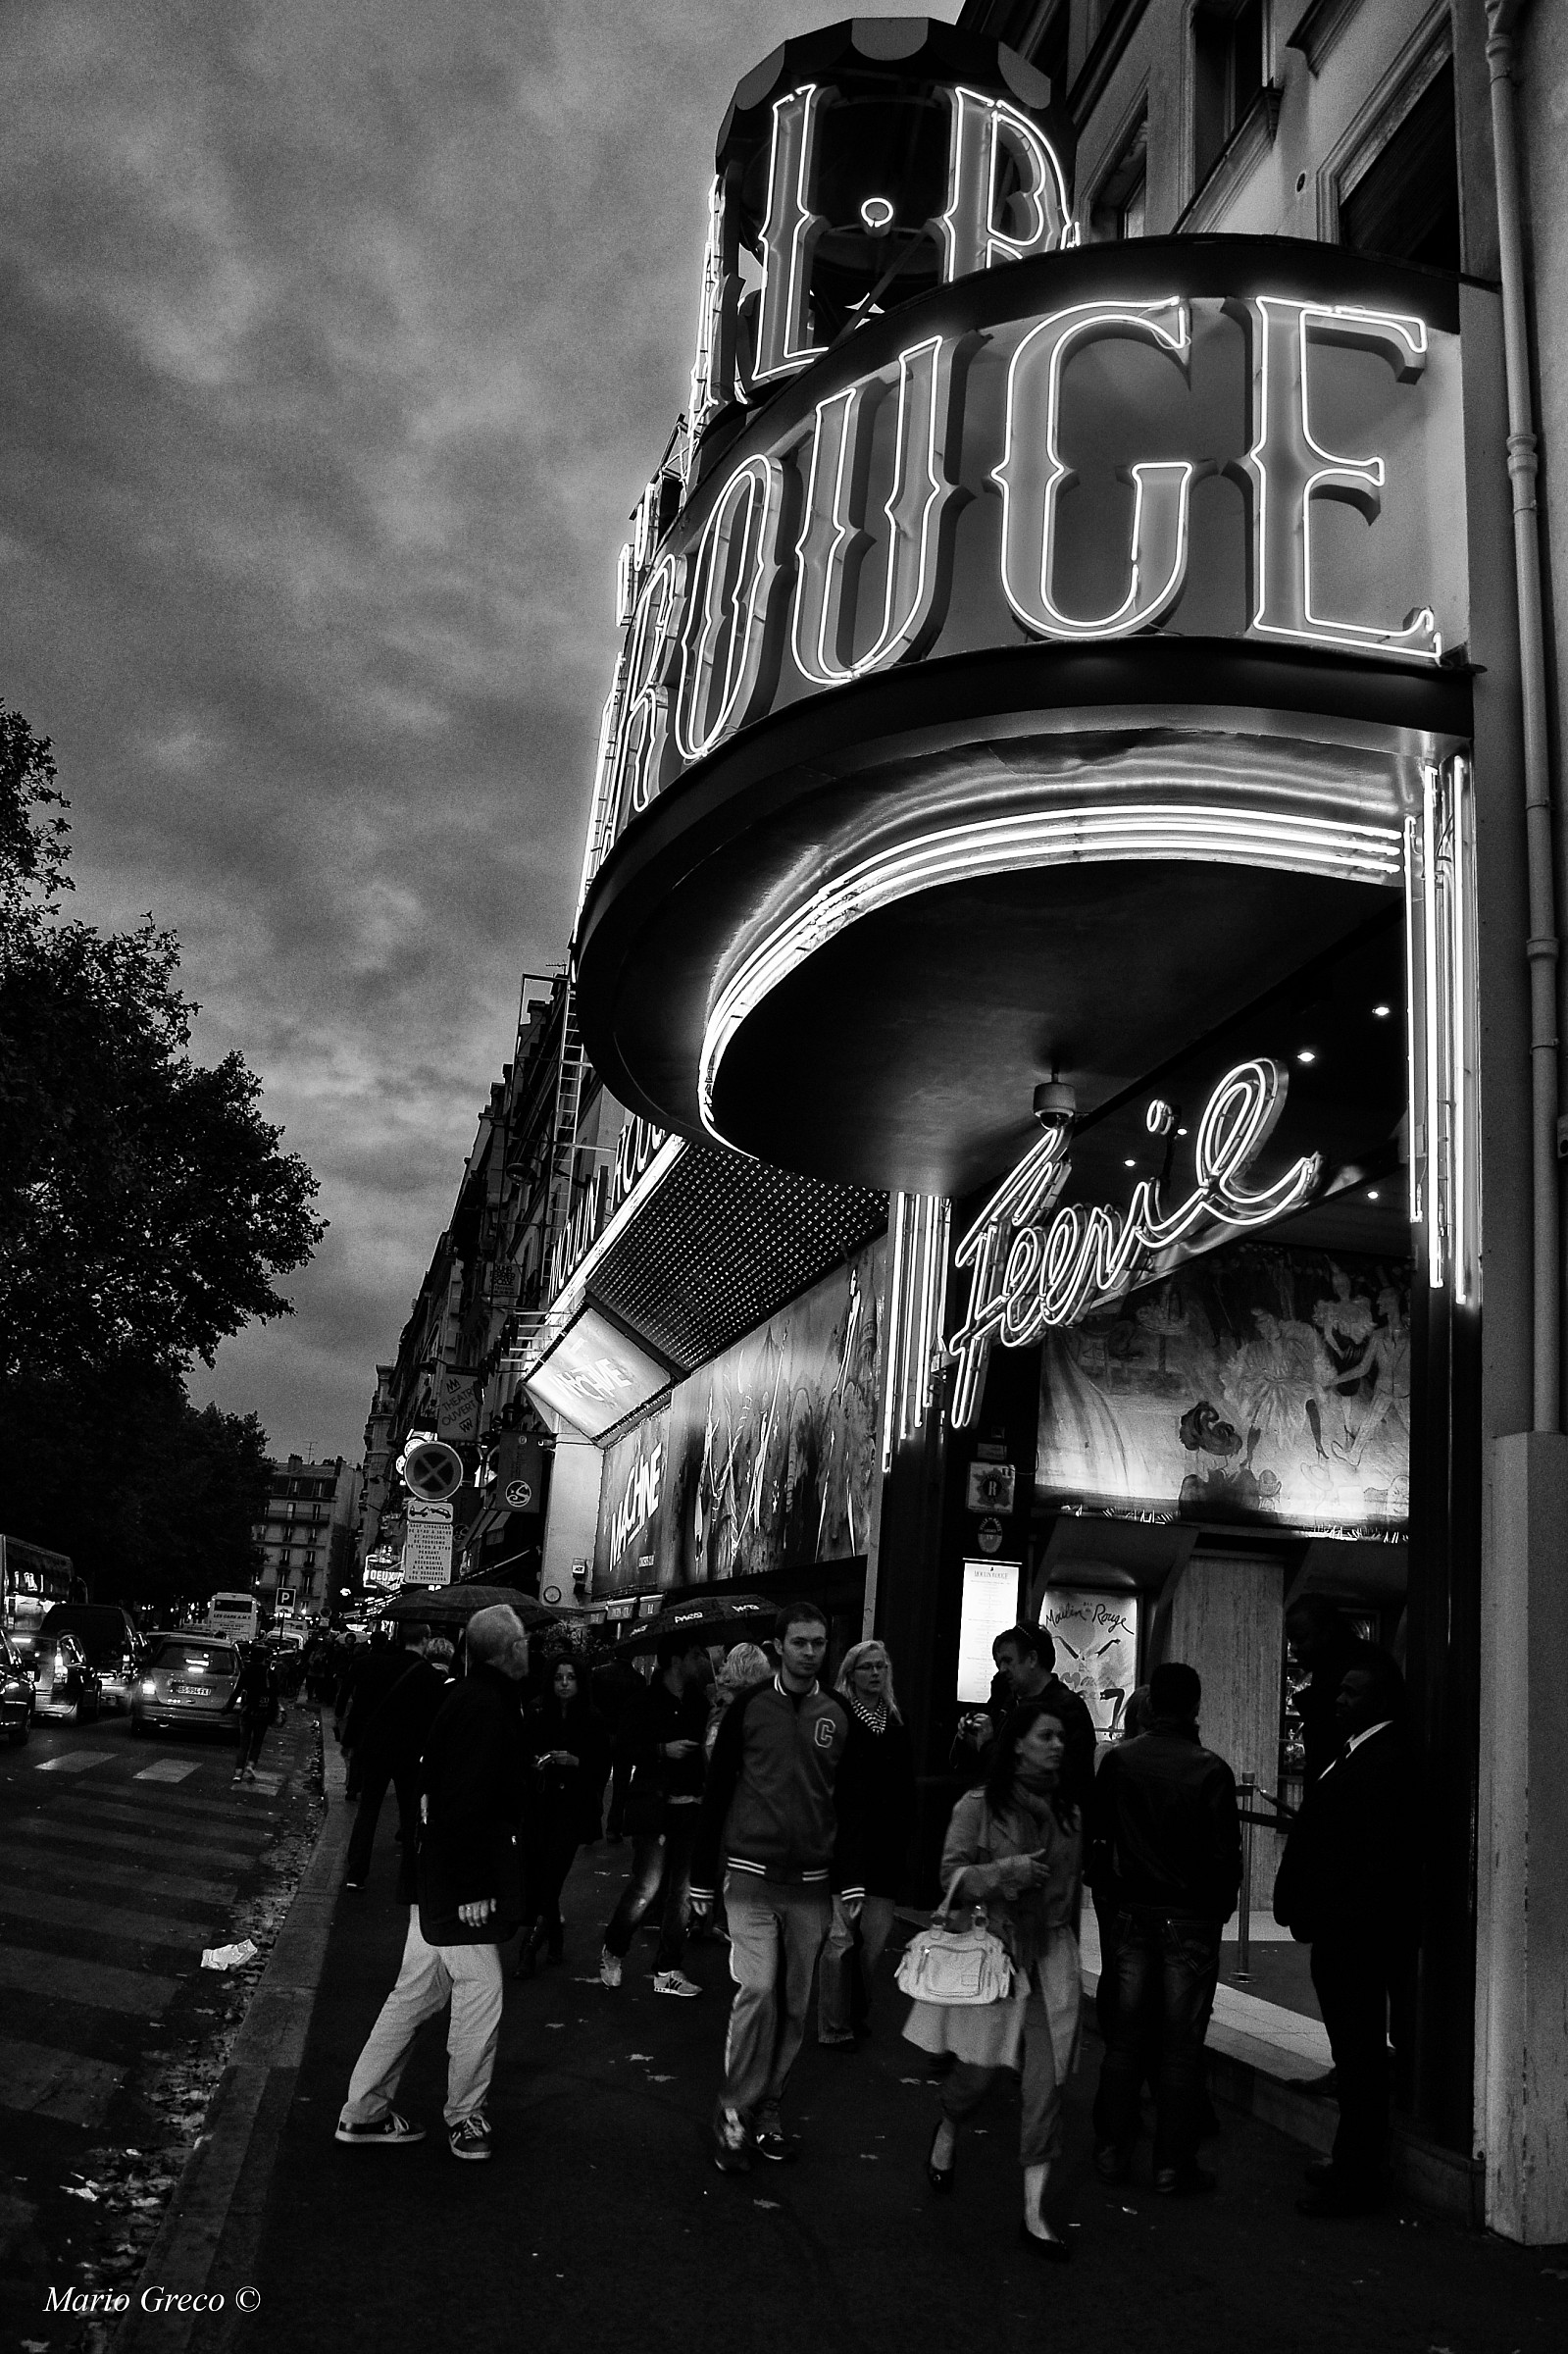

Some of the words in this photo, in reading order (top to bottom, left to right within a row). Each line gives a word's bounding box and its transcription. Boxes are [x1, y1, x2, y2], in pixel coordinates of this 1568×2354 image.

[601, 291, 1445, 863] ROUGE
[441, 1387, 475, 1412] THEATR
[441, 1400, 477, 1427] OUVERT
[1045, 1602, 1087, 1627] Moulin
[1092, 1603, 1135, 1634] Rouge
